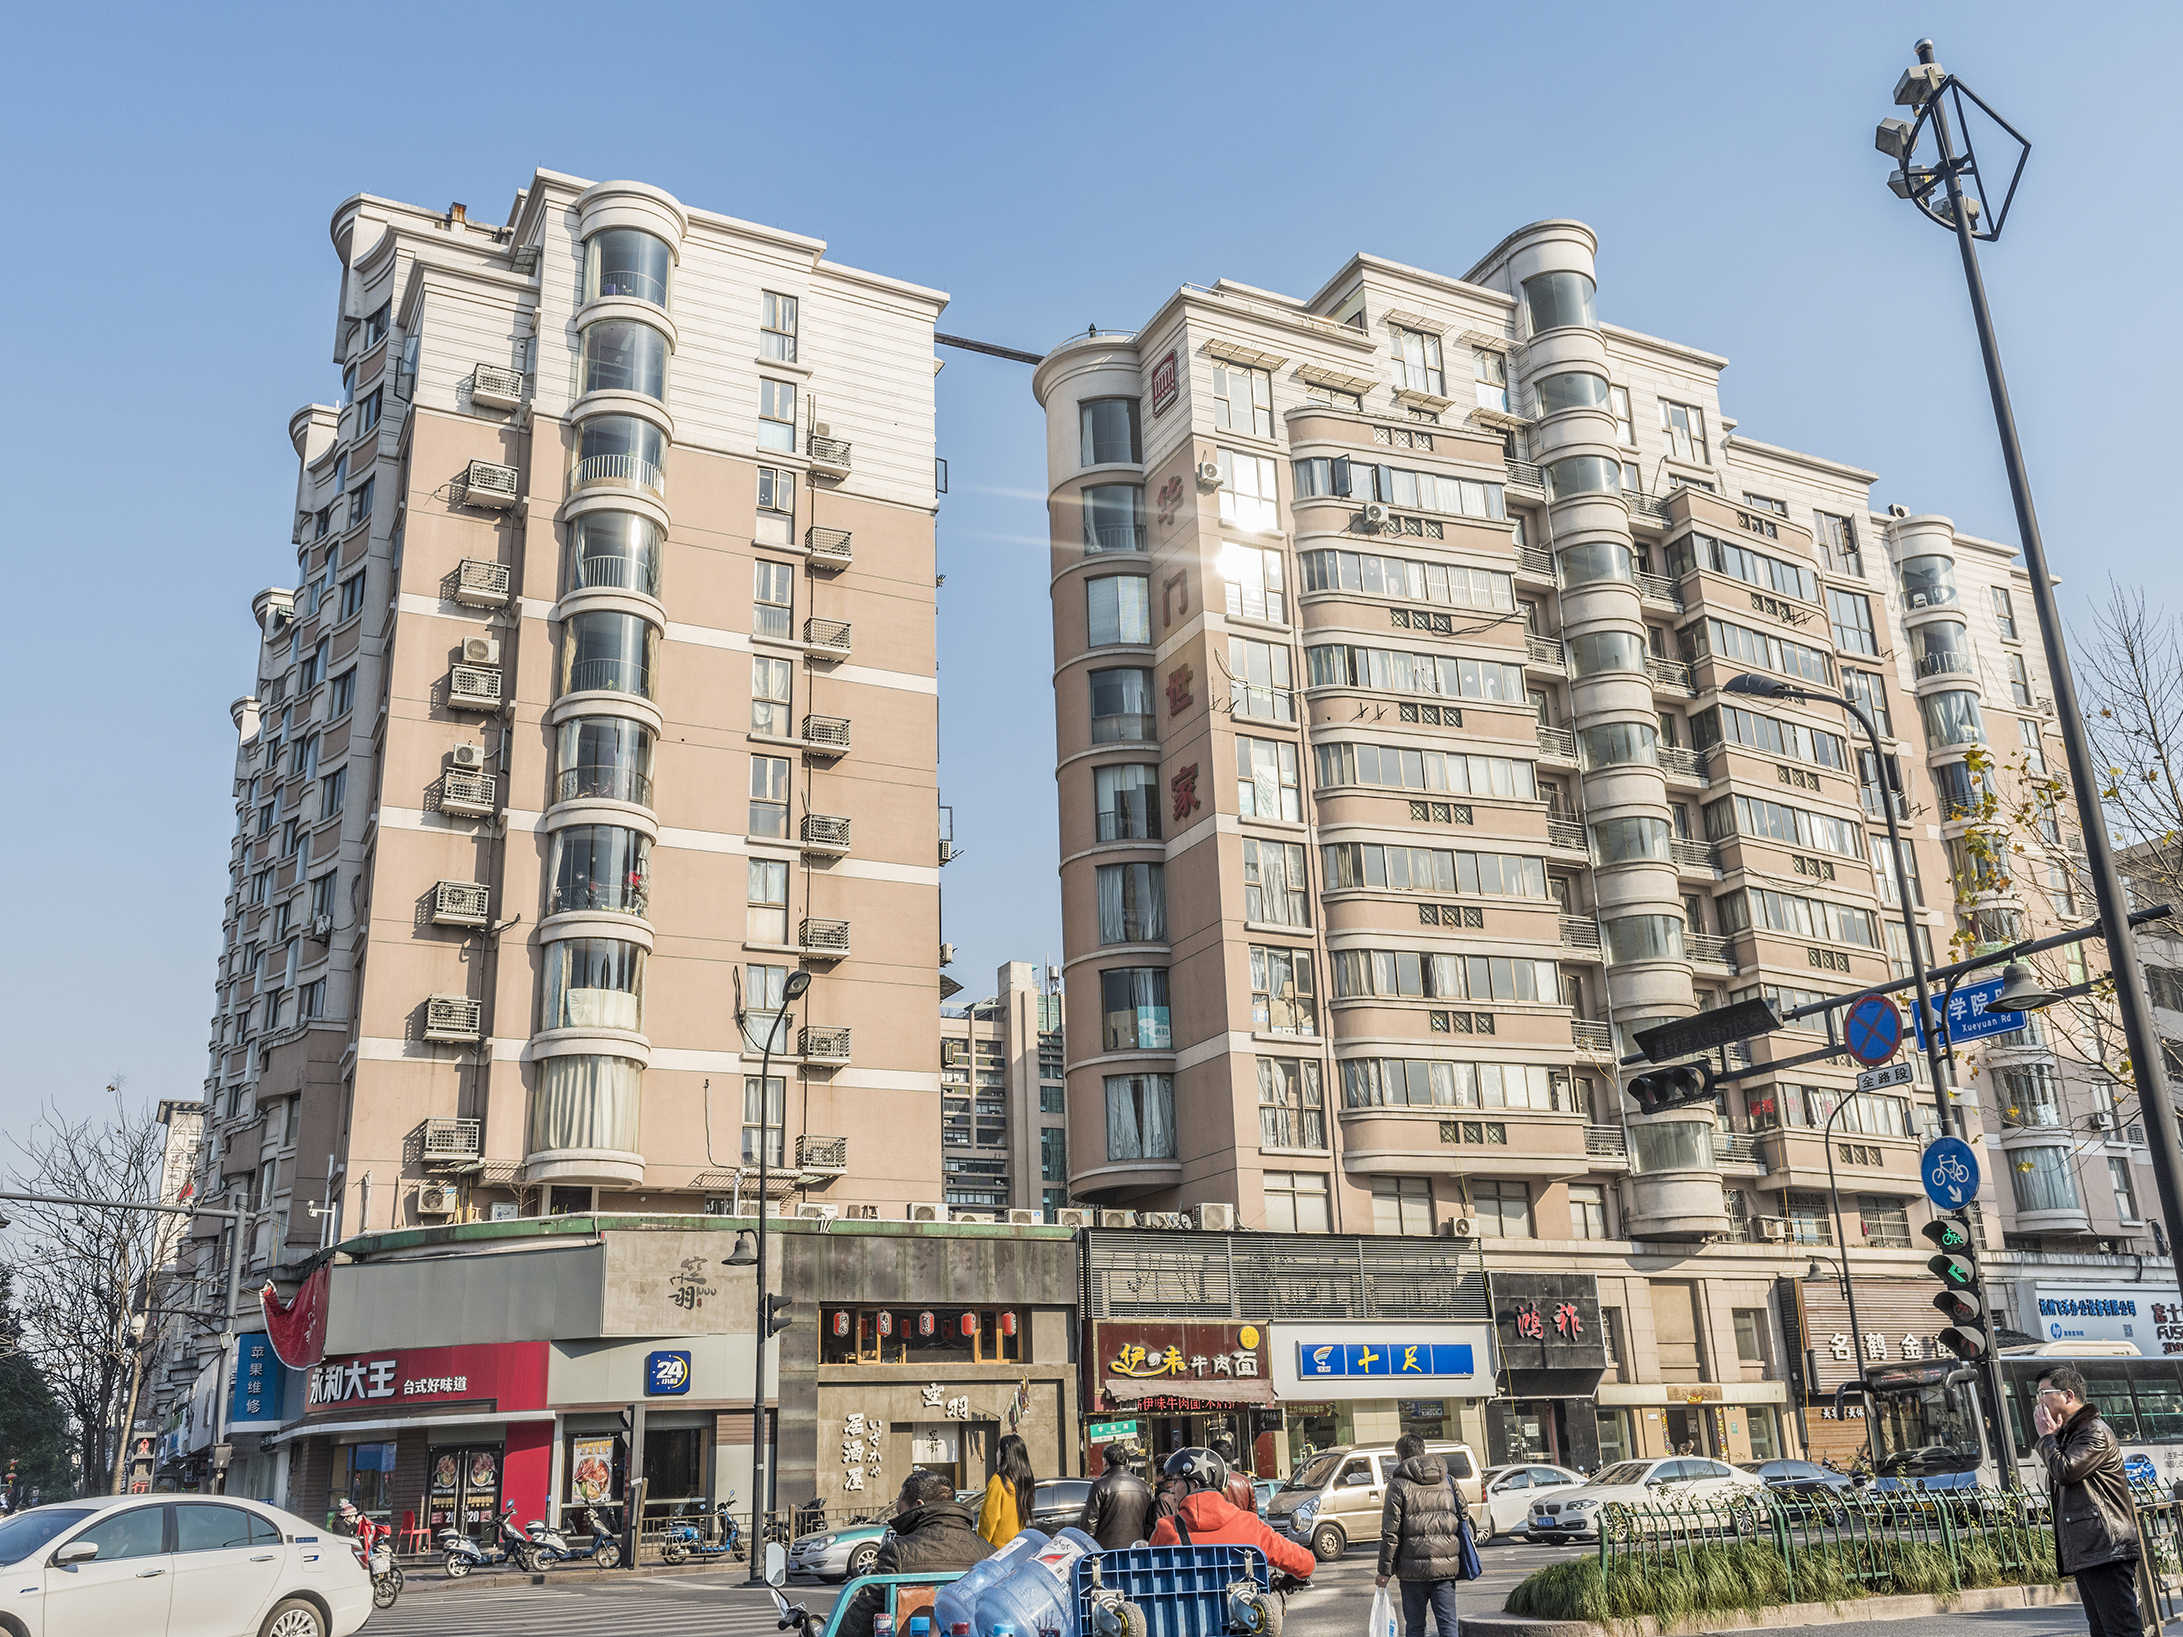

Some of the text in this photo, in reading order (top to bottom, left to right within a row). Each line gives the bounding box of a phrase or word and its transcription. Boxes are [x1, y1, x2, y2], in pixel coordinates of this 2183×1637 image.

[1156, 475, 1201, 822] 华门世家
[1949, 985, 2005, 1021] 学院
[1961, 1013, 2012, 1033] Xueyuan Rd
[1861, 1067, 1909, 1089] 全路段
[2151, 1303, 2183, 1324] 富士
[2052, 1324, 2061, 1339] hp
[656, 1361, 684, 1379] 24
[1357, 1345, 1422, 1374] 十足
[246, 1345, 265, 1414] 苹果维修
[309, 1360, 398, 1404] 永和大王
[403, 1376, 468, 1396] 台式好味道
[921, 1382, 969, 1419] 空羽
[842, 1412, 866, 1491] 居酒屋
